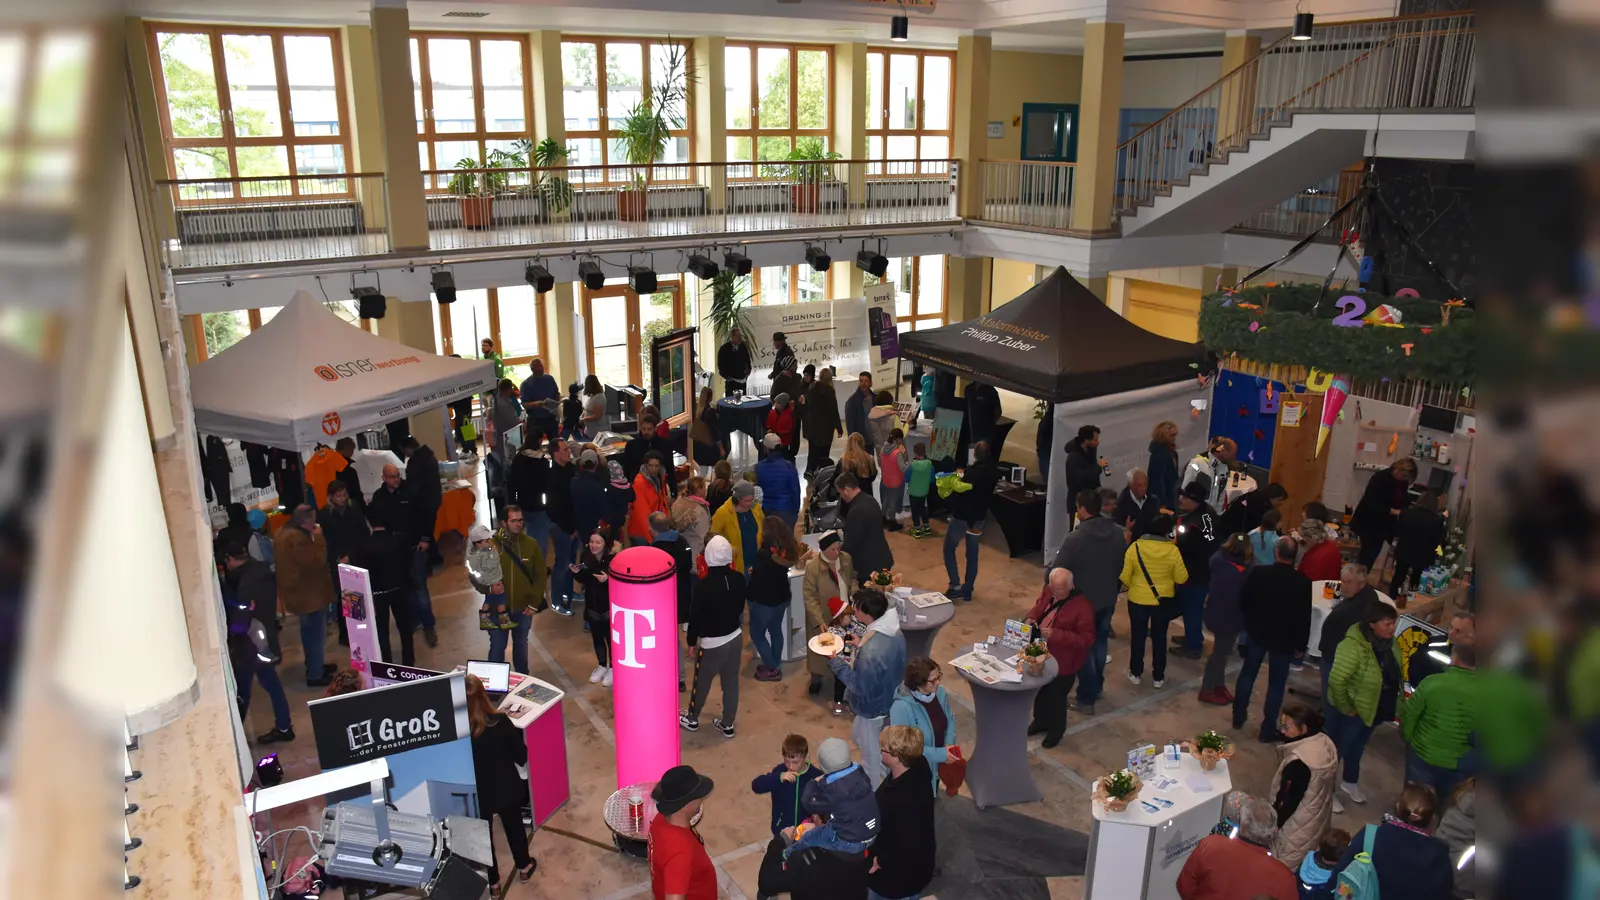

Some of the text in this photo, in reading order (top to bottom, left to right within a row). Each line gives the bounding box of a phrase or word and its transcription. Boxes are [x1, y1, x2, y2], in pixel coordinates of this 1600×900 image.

[961, 327, 1037, 352] Philipp Zuber
[977, 317, 1050, 342] Malermeister
[802, 341, 835, 353] Jahren
[840, 339, 853, 348] Ihr
[611, 602, 656, 669] T
[379, 708, 441, 742] Groß
[377, 732, 441, 751] Fenstermacher
